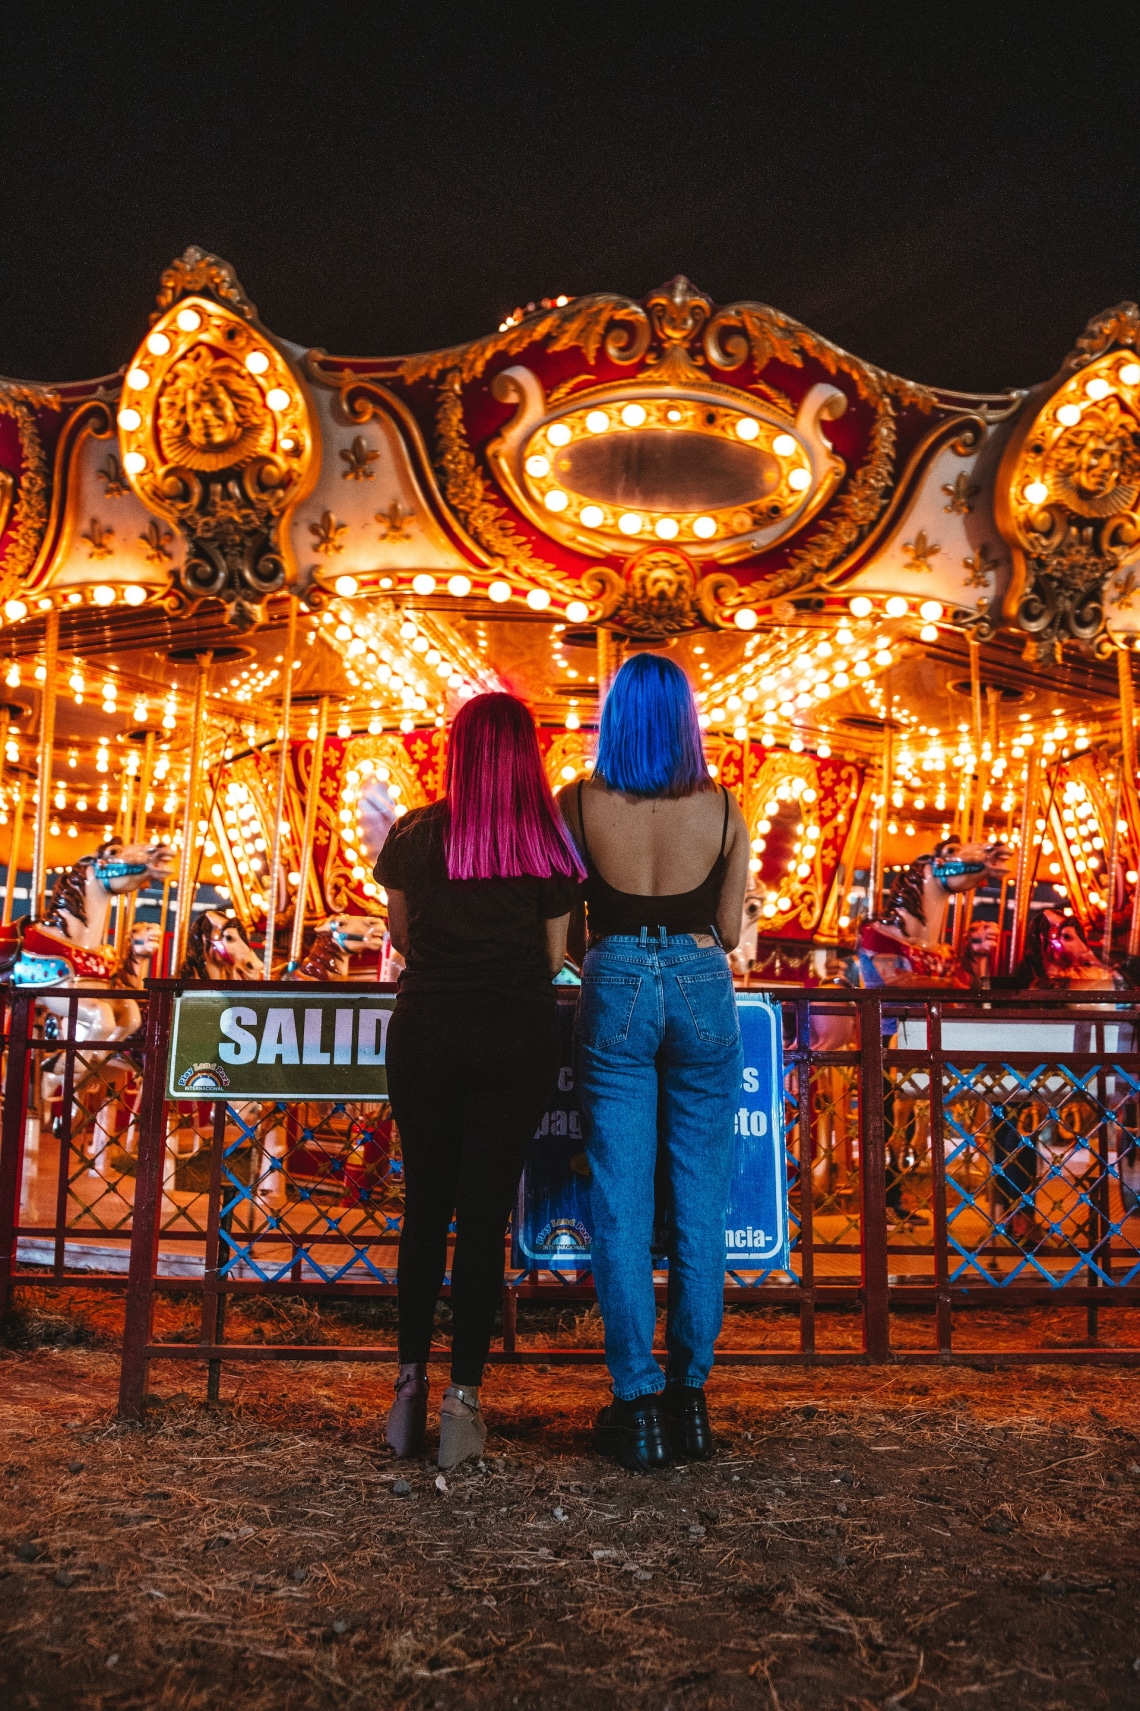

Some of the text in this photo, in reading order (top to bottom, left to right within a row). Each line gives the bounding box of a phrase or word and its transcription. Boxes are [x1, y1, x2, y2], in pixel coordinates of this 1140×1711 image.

[218, 1006, 394, 1065] SALID
[178, 1063, 231, 1087] Play Land Park
[535, 1218, 592, 1245] Play Land Park
